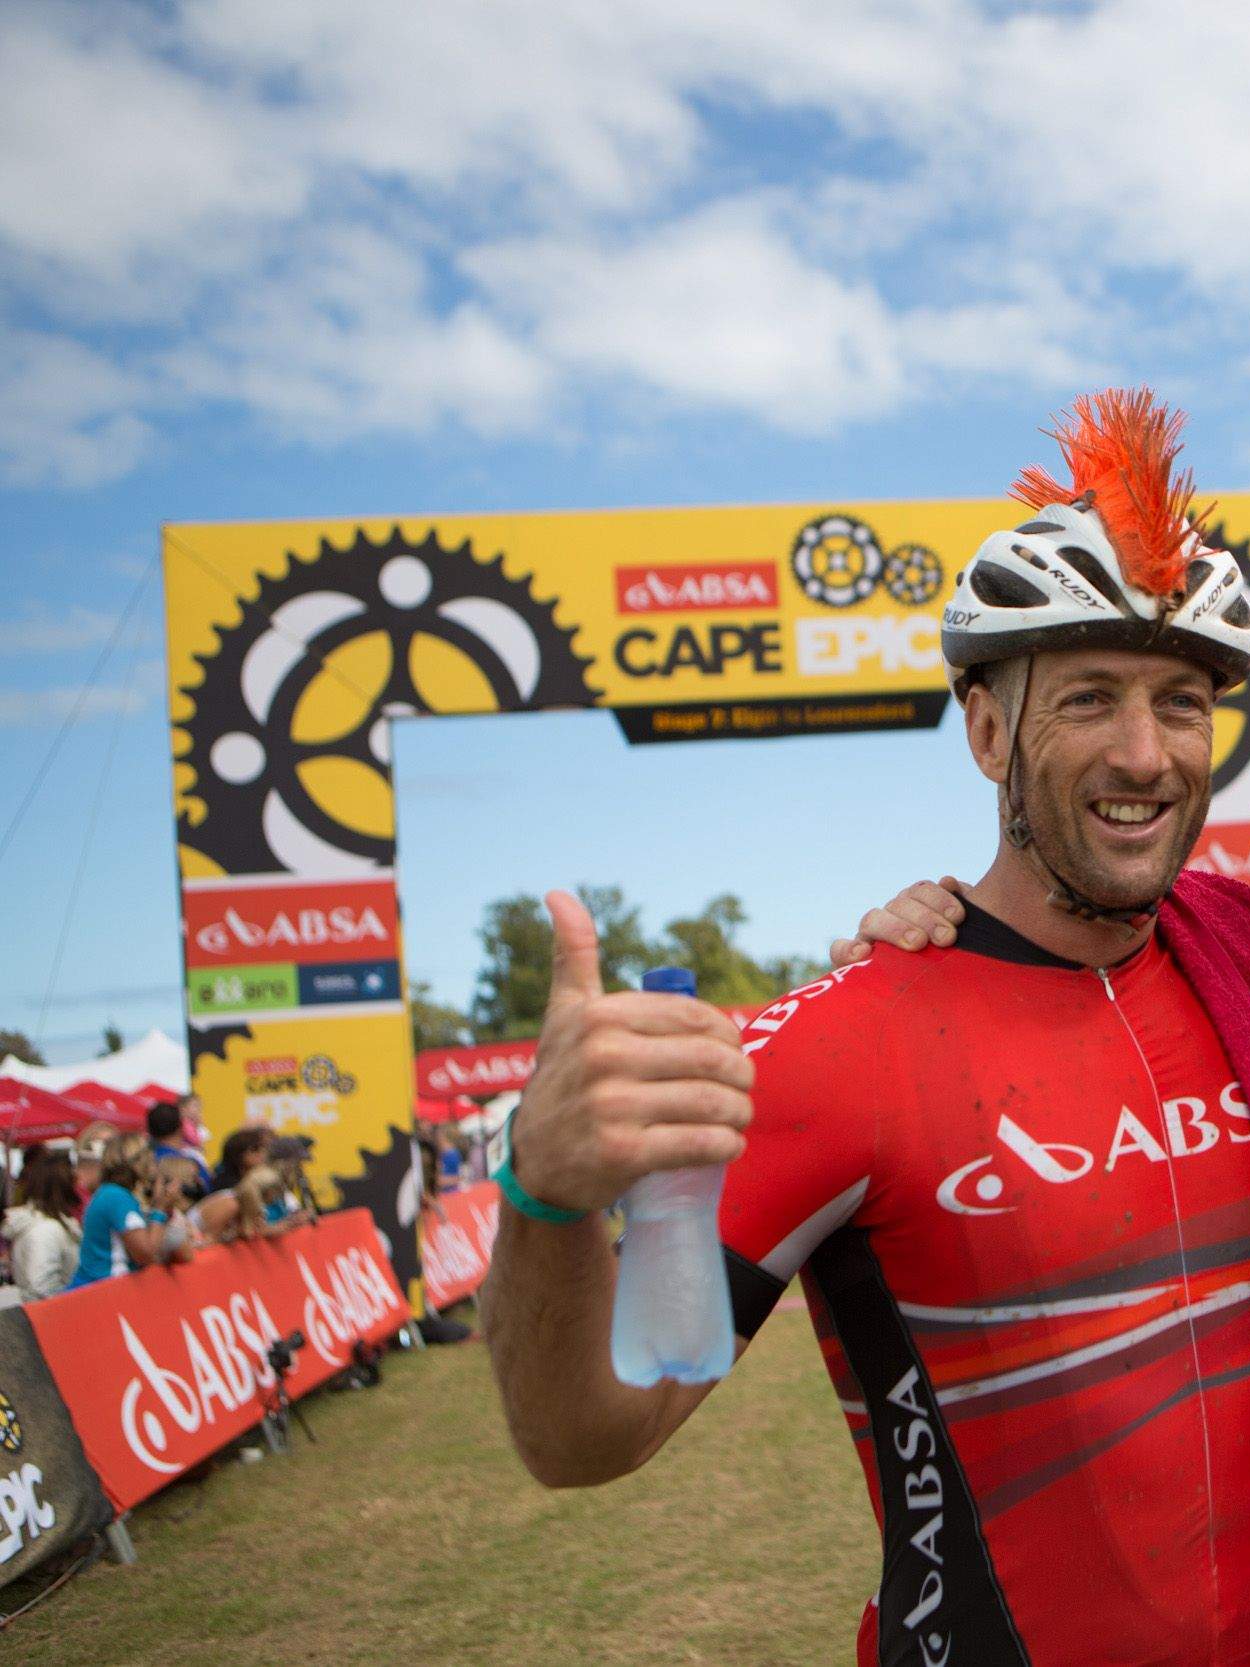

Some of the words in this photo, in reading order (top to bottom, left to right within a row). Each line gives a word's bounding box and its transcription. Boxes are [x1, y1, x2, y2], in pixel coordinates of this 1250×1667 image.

[676, 572, 772, 606] ABSA
[1048, 569, 1106, 610] RUDY
[1192, 580, 1223, 622] RUDY
[614, 622, 784, 678] CAPE
[794, 614, 942, 676] EPIC
[267, 906, 388, 946] ABSA
[886, 1364, 944, 1567] ABSA
[0, 1462, 56, 1563] PIC
